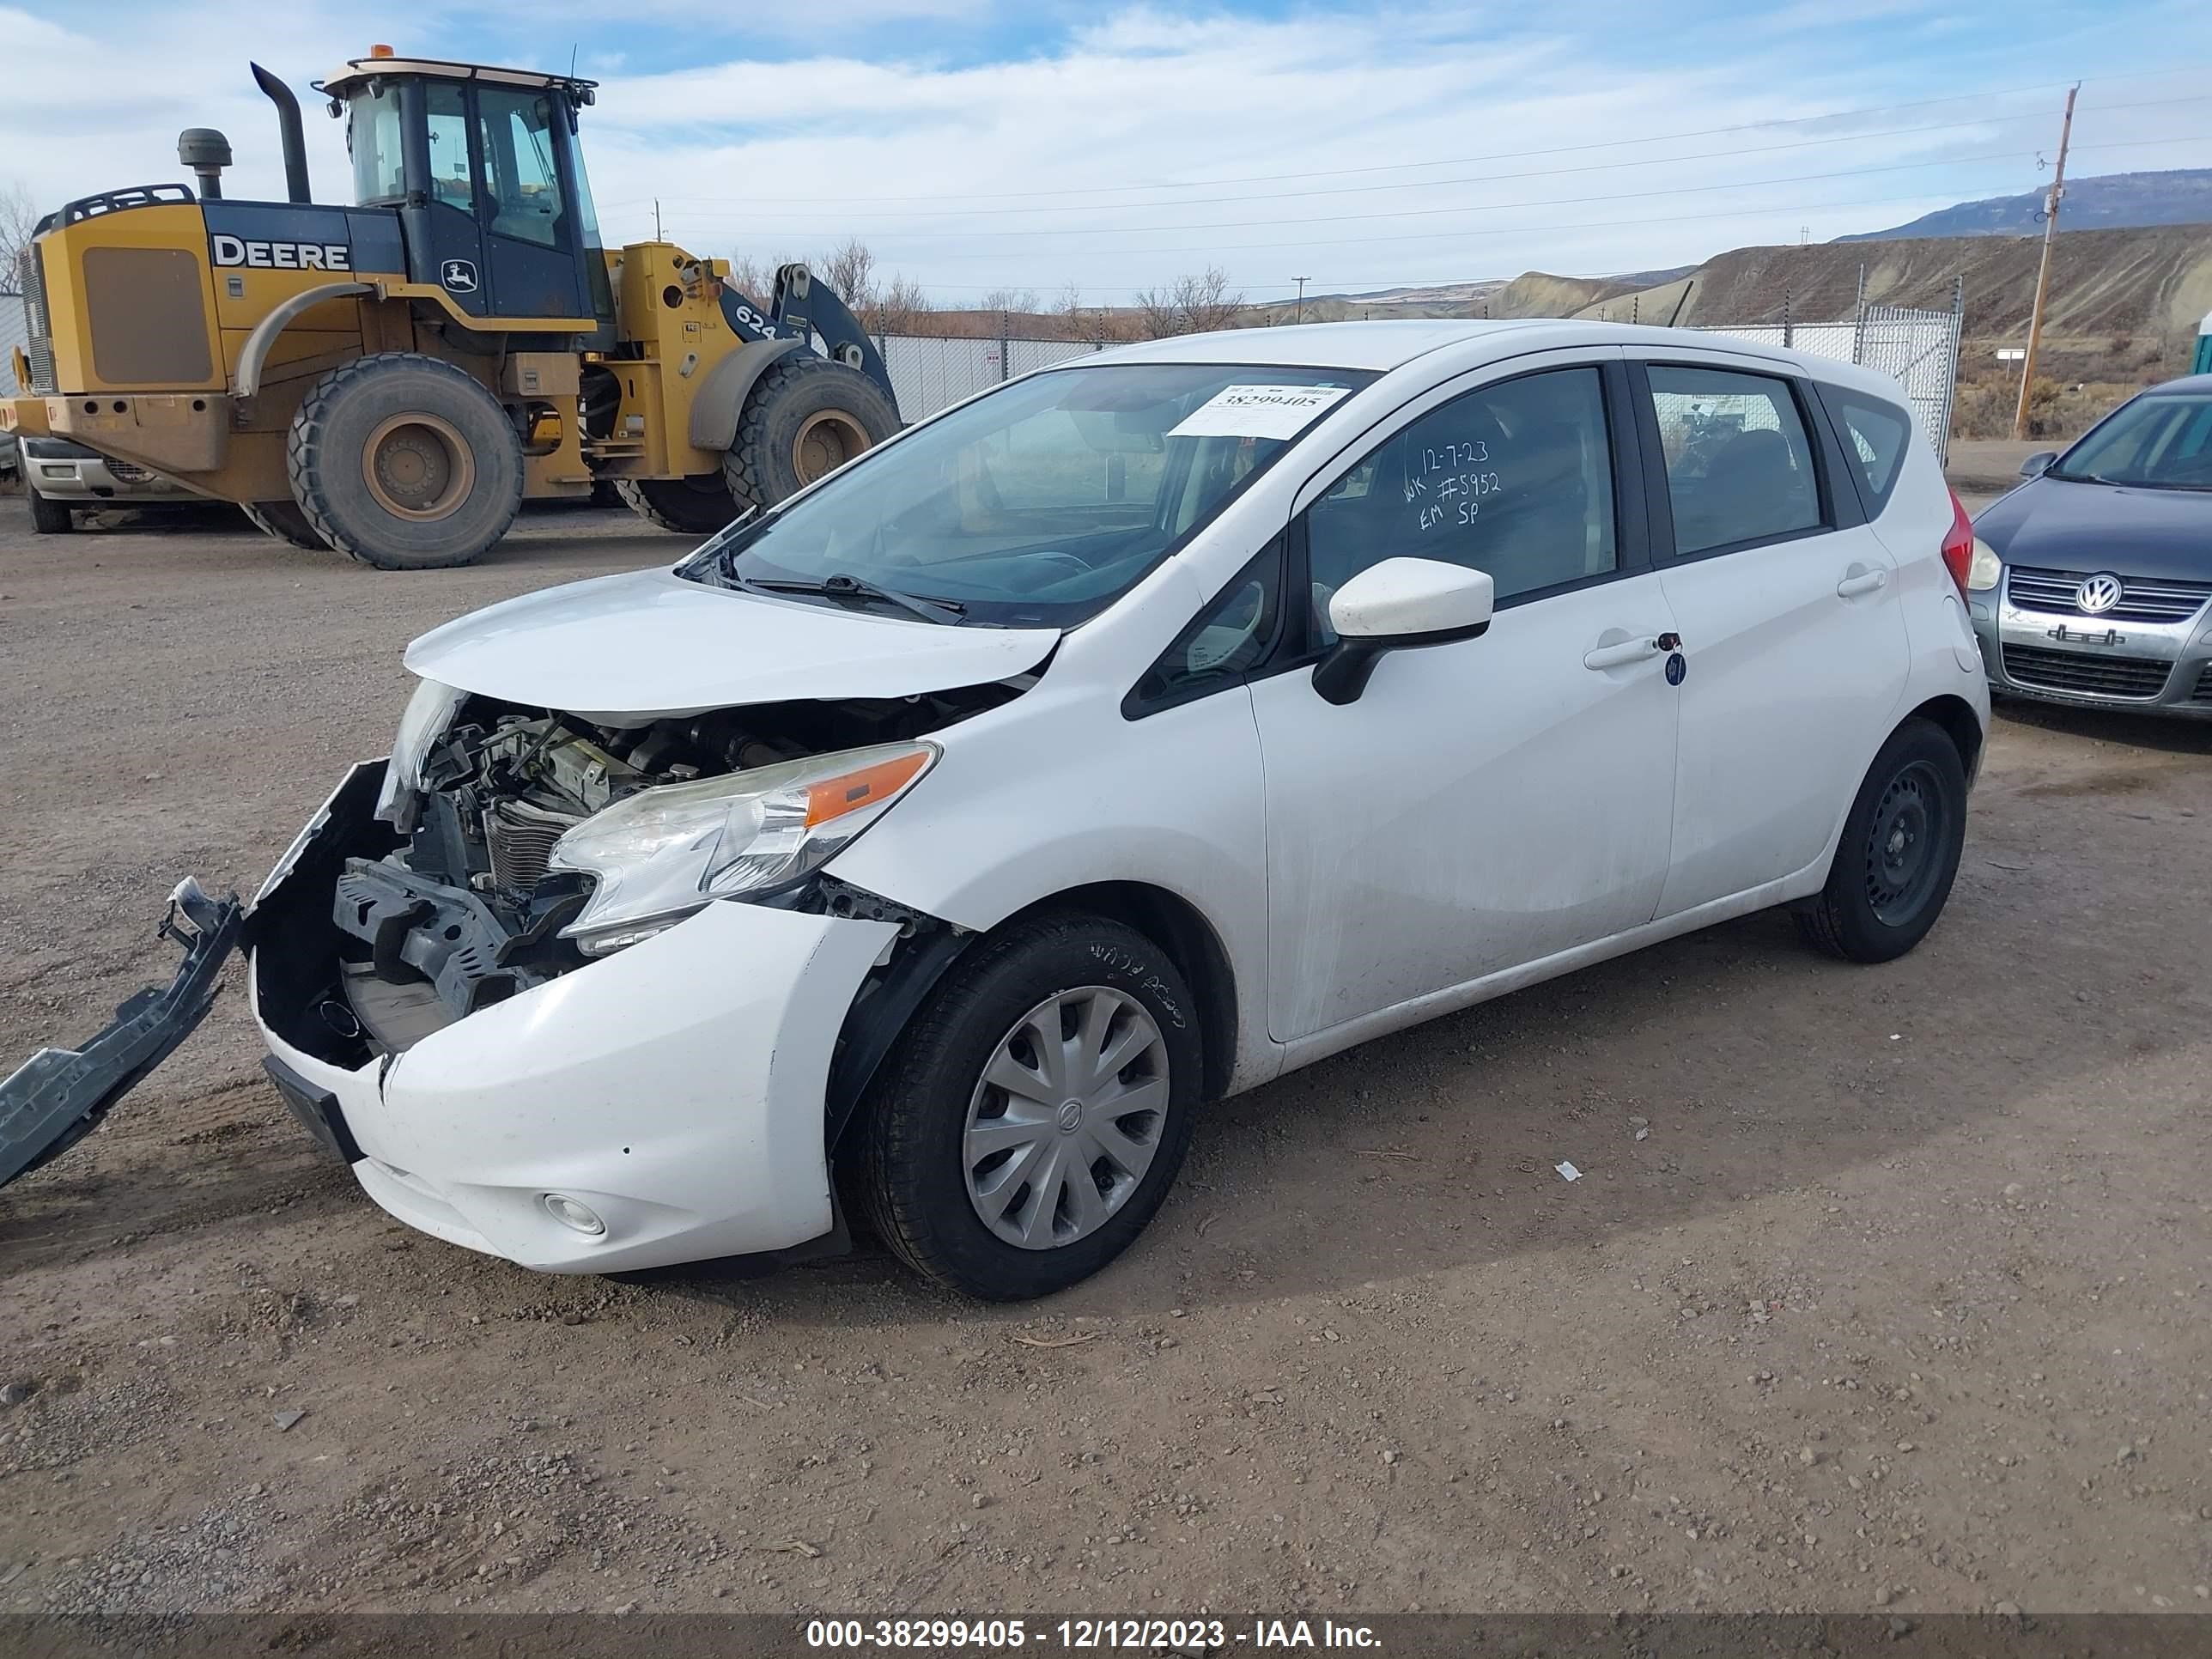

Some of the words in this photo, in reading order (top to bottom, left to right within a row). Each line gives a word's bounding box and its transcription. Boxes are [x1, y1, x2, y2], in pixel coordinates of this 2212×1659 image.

[213, 234, 350, 270] DEERE
[736, 305, 777, 341] 624
[1218, 394, 1322, 408] 38299405
[1422, 441, 1489, 475] 12-7-23
[1437, 472, 1502, 502] #5952
